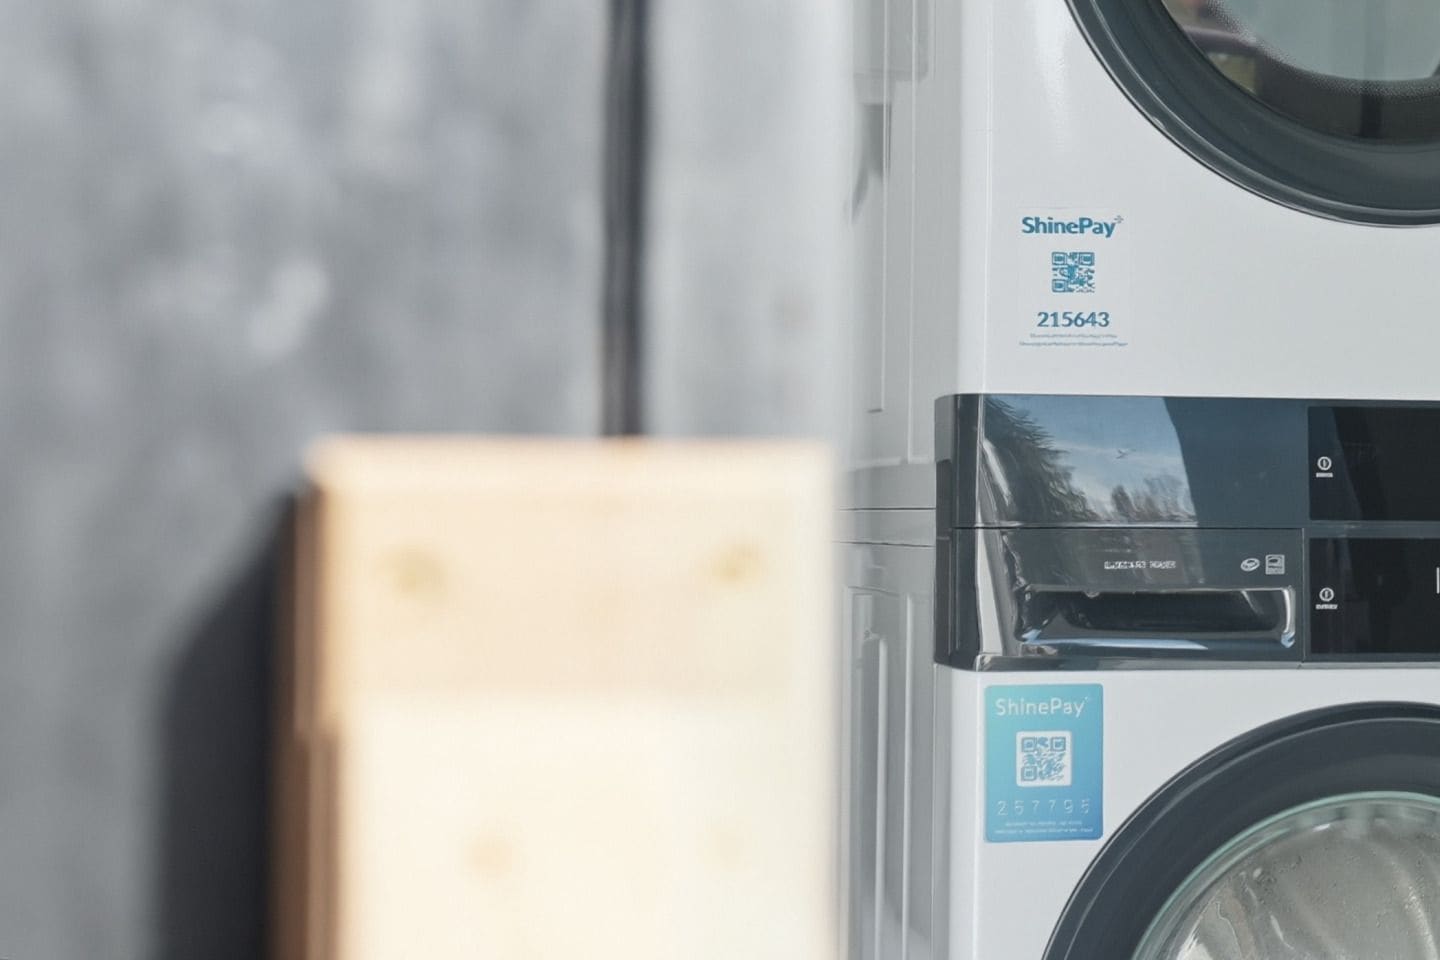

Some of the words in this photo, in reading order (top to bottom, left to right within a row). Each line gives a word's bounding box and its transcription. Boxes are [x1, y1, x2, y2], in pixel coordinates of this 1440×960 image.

[1021, 216, 1116, 238] ShinePay
[1036, 311, 1111, 328] 215643
[994, 697, 1086, 718] ShinePay
